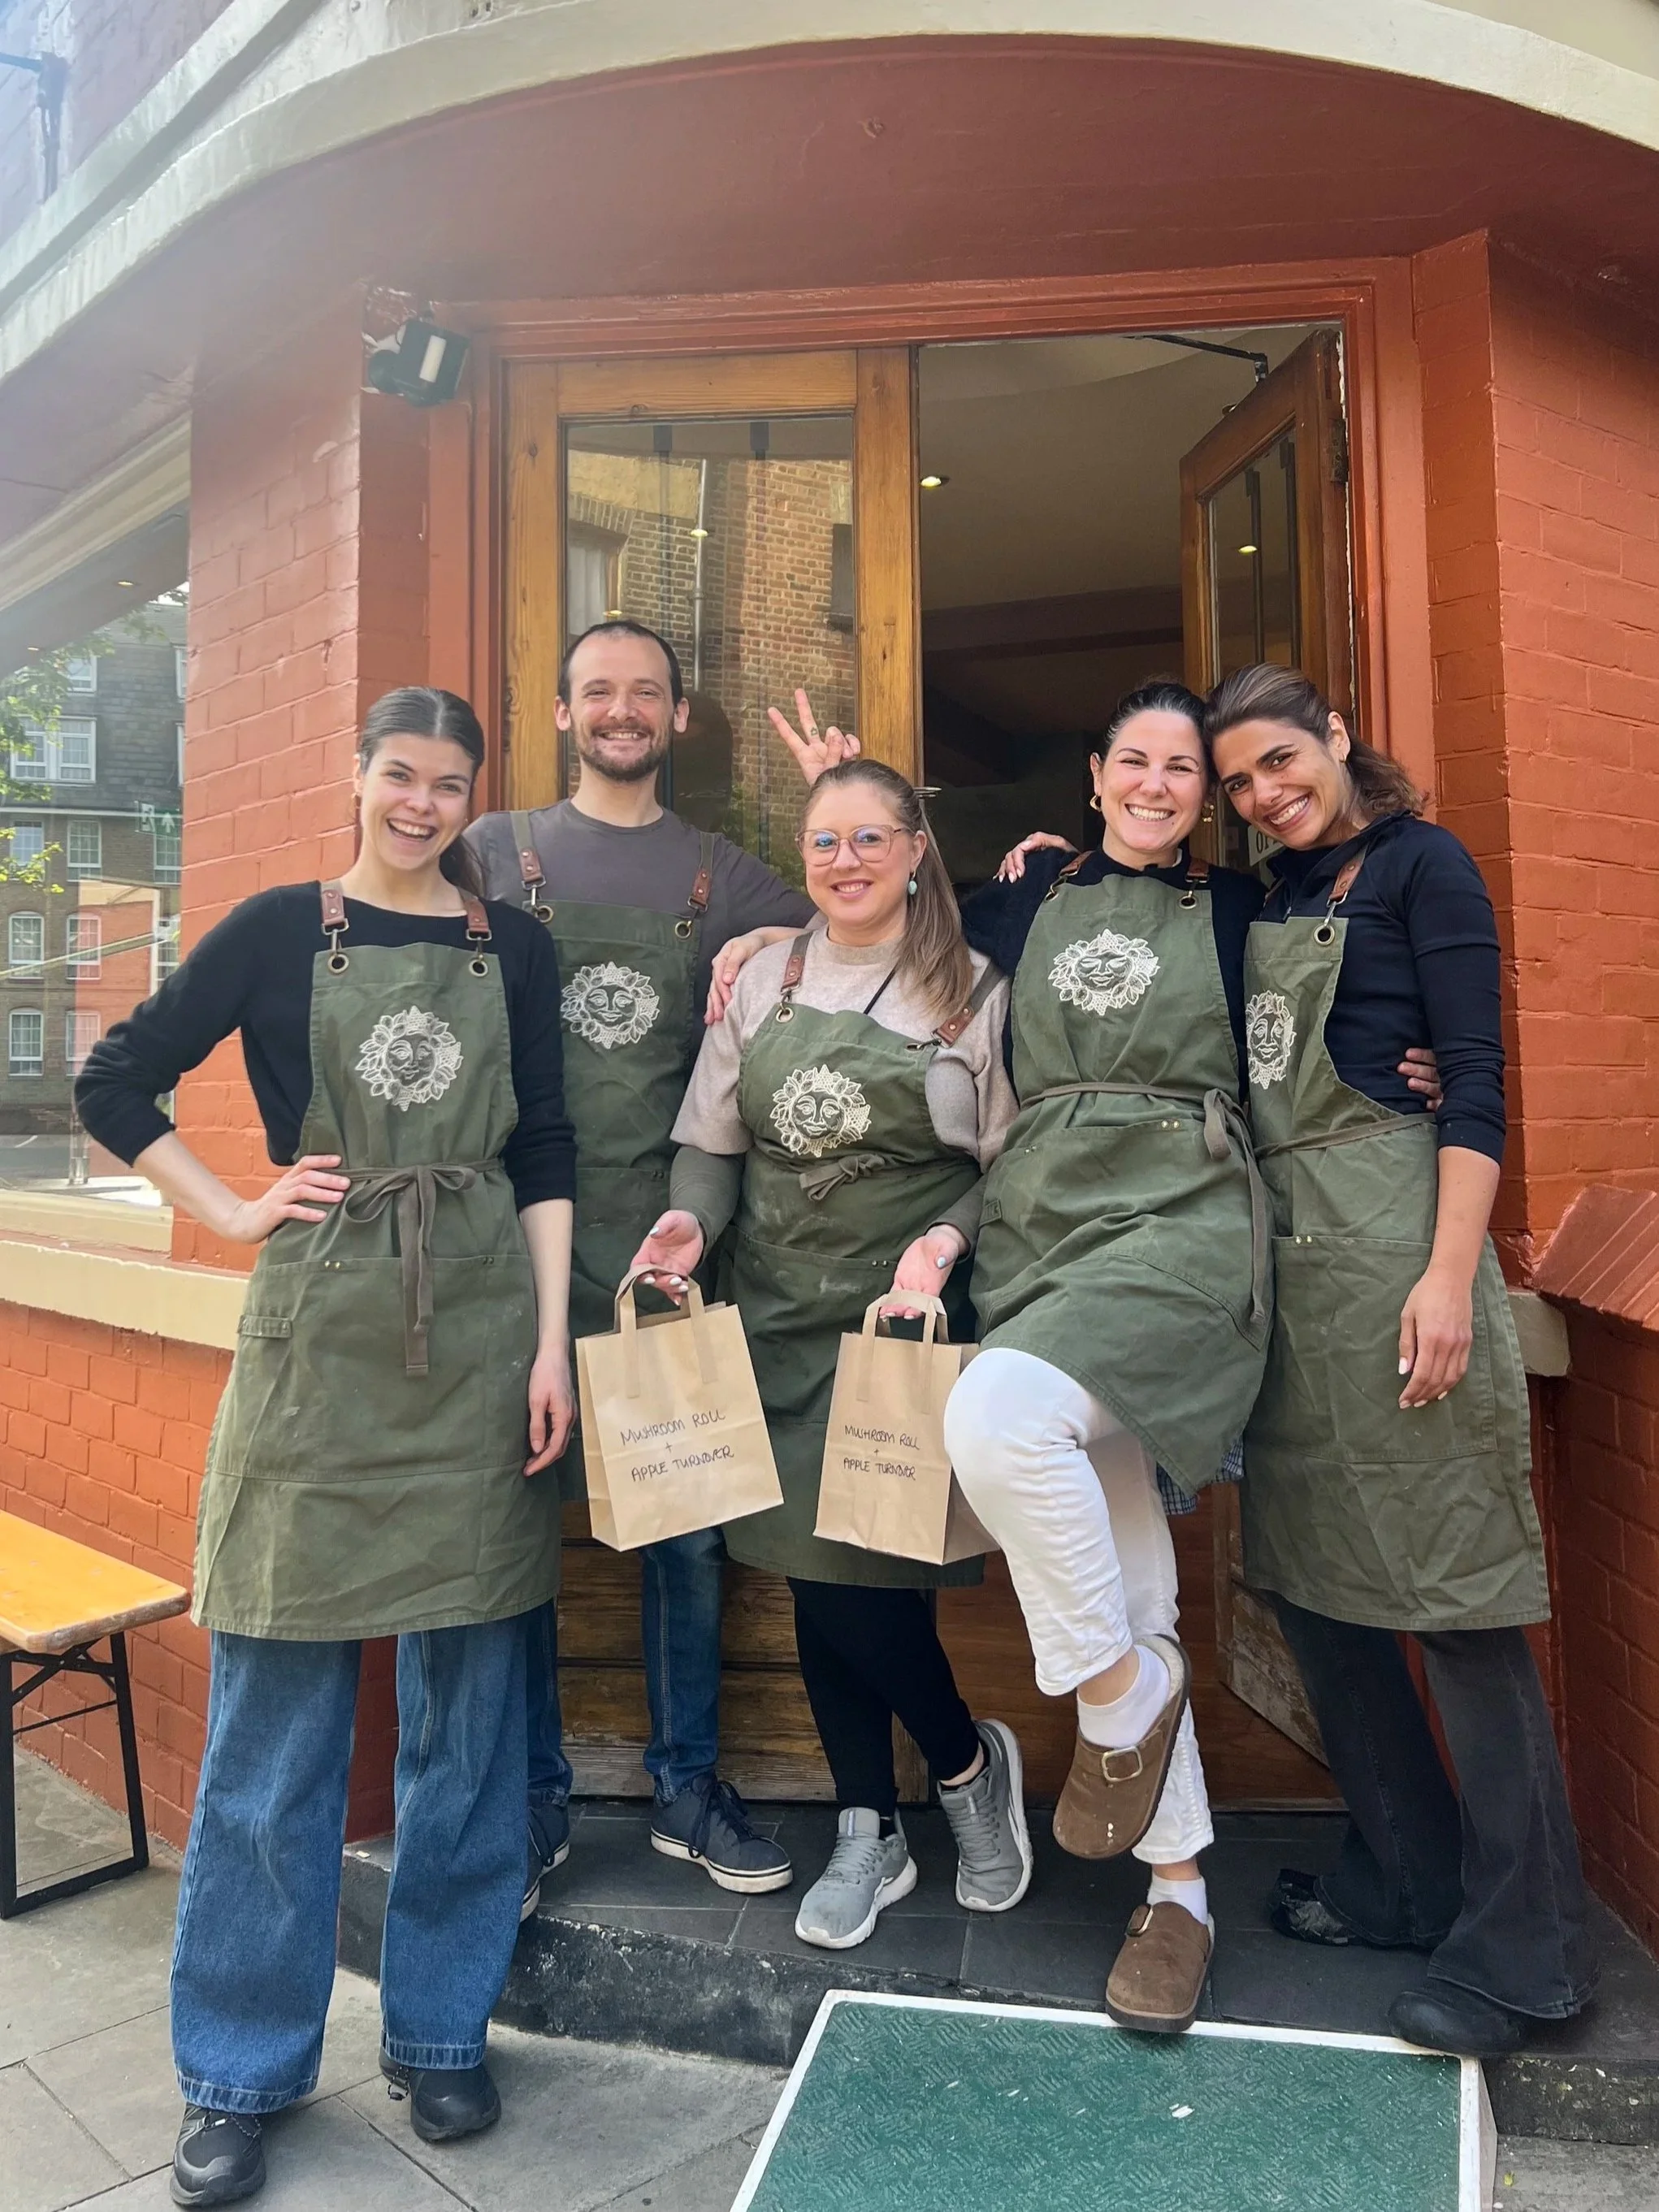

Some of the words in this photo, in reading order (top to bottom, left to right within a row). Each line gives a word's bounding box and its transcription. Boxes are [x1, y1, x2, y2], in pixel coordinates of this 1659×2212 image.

[620, 1418, 686, 1446] MUSHROOM
[692, 1409, 726, 1428] ROLL
[844, 1424, 895, 1444] MUSHROOM
[899, 1433, 920, 1451] ROLL
[630, 1461, 669, 1483] APPLE
[672, 1444, 734, 1470] TURNOVER
[843, 1457, 870, 1473] APPLE
